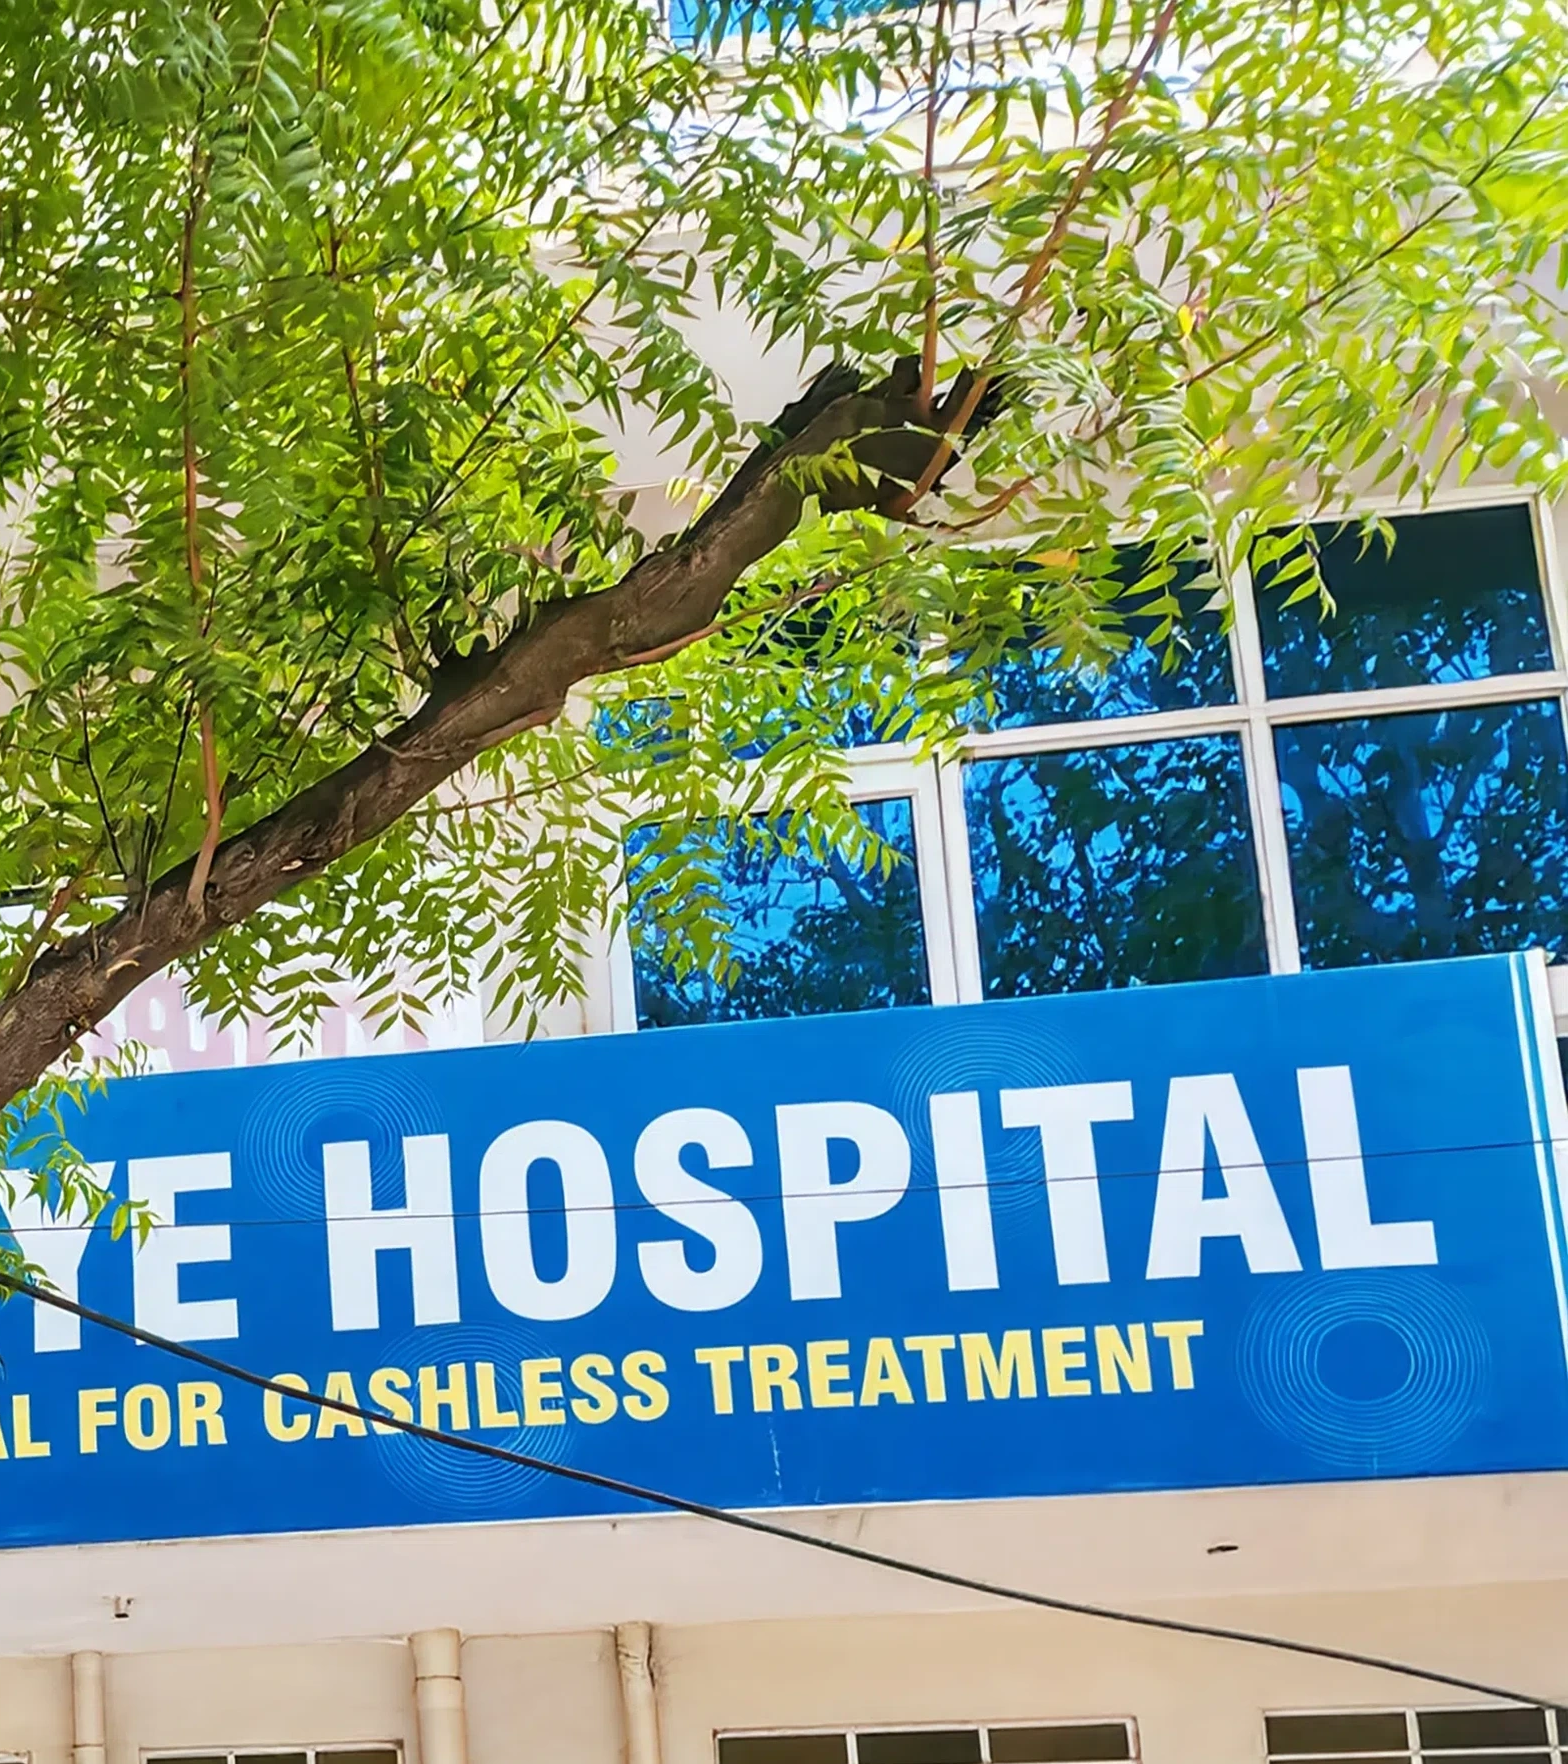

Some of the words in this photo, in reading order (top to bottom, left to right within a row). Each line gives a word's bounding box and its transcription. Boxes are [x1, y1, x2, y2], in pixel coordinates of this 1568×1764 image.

[322, 1065, 1440, 1332] HOSPITAL
[78, 1381, 228, 1455] FOR
[262, 1351, 670, 1444] CASHLESS
[696, 1320, 1205, 1415] TREATMENT
